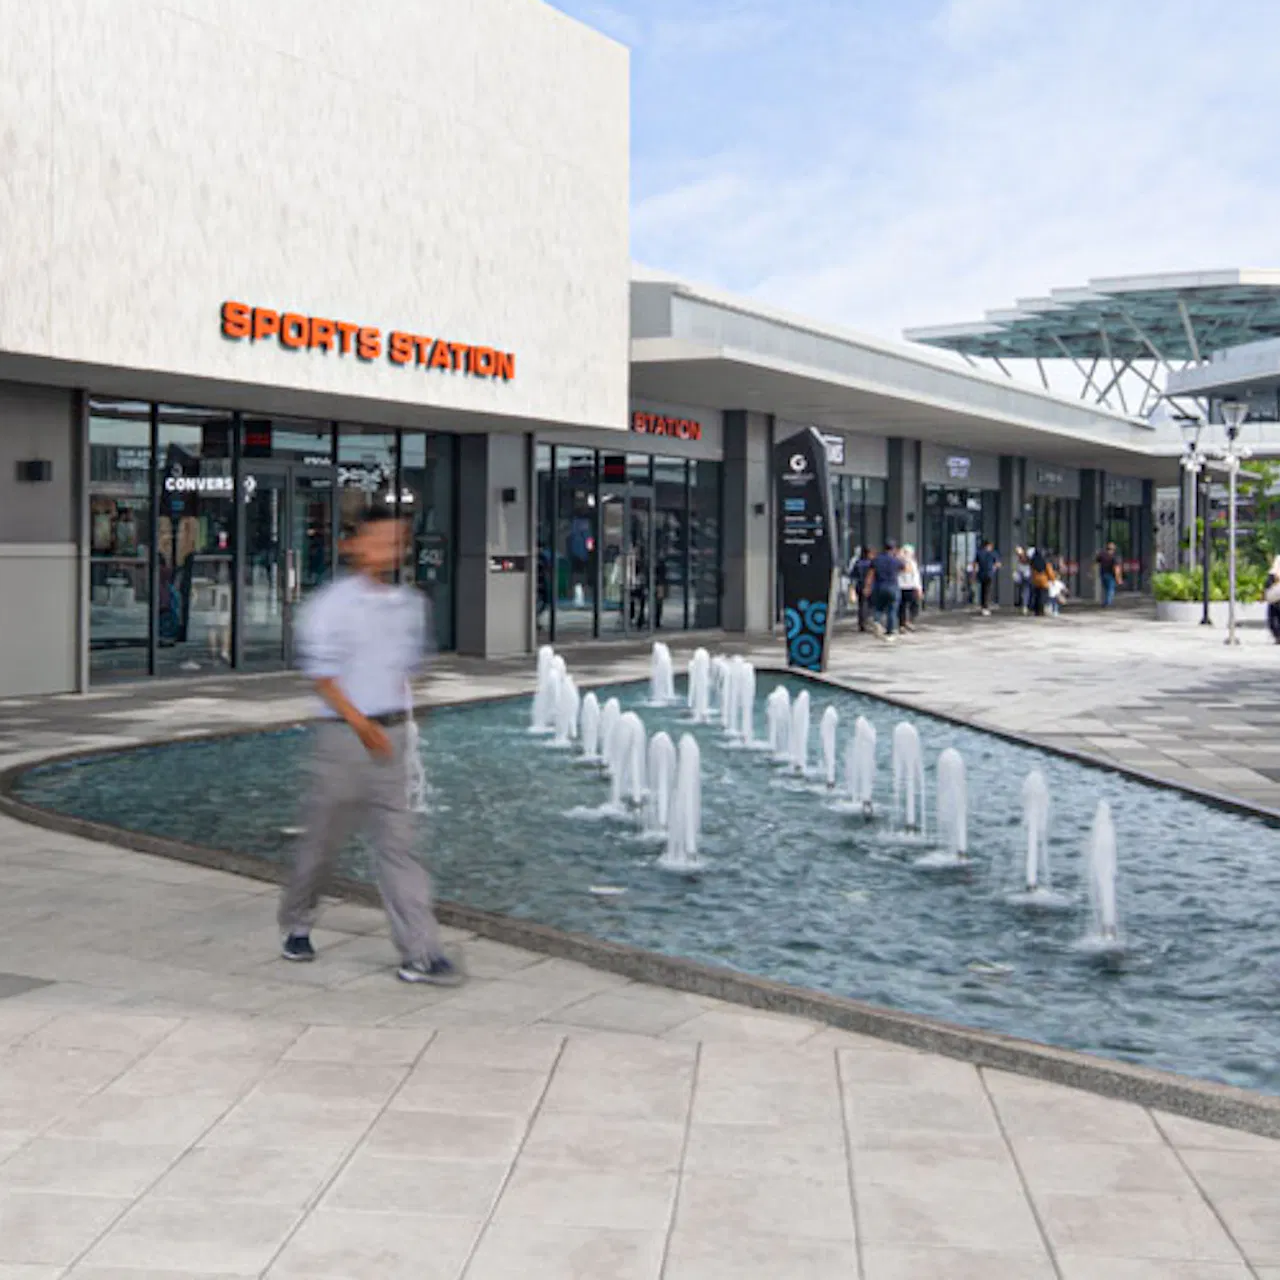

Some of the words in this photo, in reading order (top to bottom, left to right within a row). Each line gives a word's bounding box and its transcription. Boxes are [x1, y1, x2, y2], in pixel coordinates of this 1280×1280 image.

[221, 301, 382, 361] SPORTS
[390, 330, 515, 381] STATION
[633, 410, 702, 440] STATION
[165, 476, 234, 492] CONVERS
